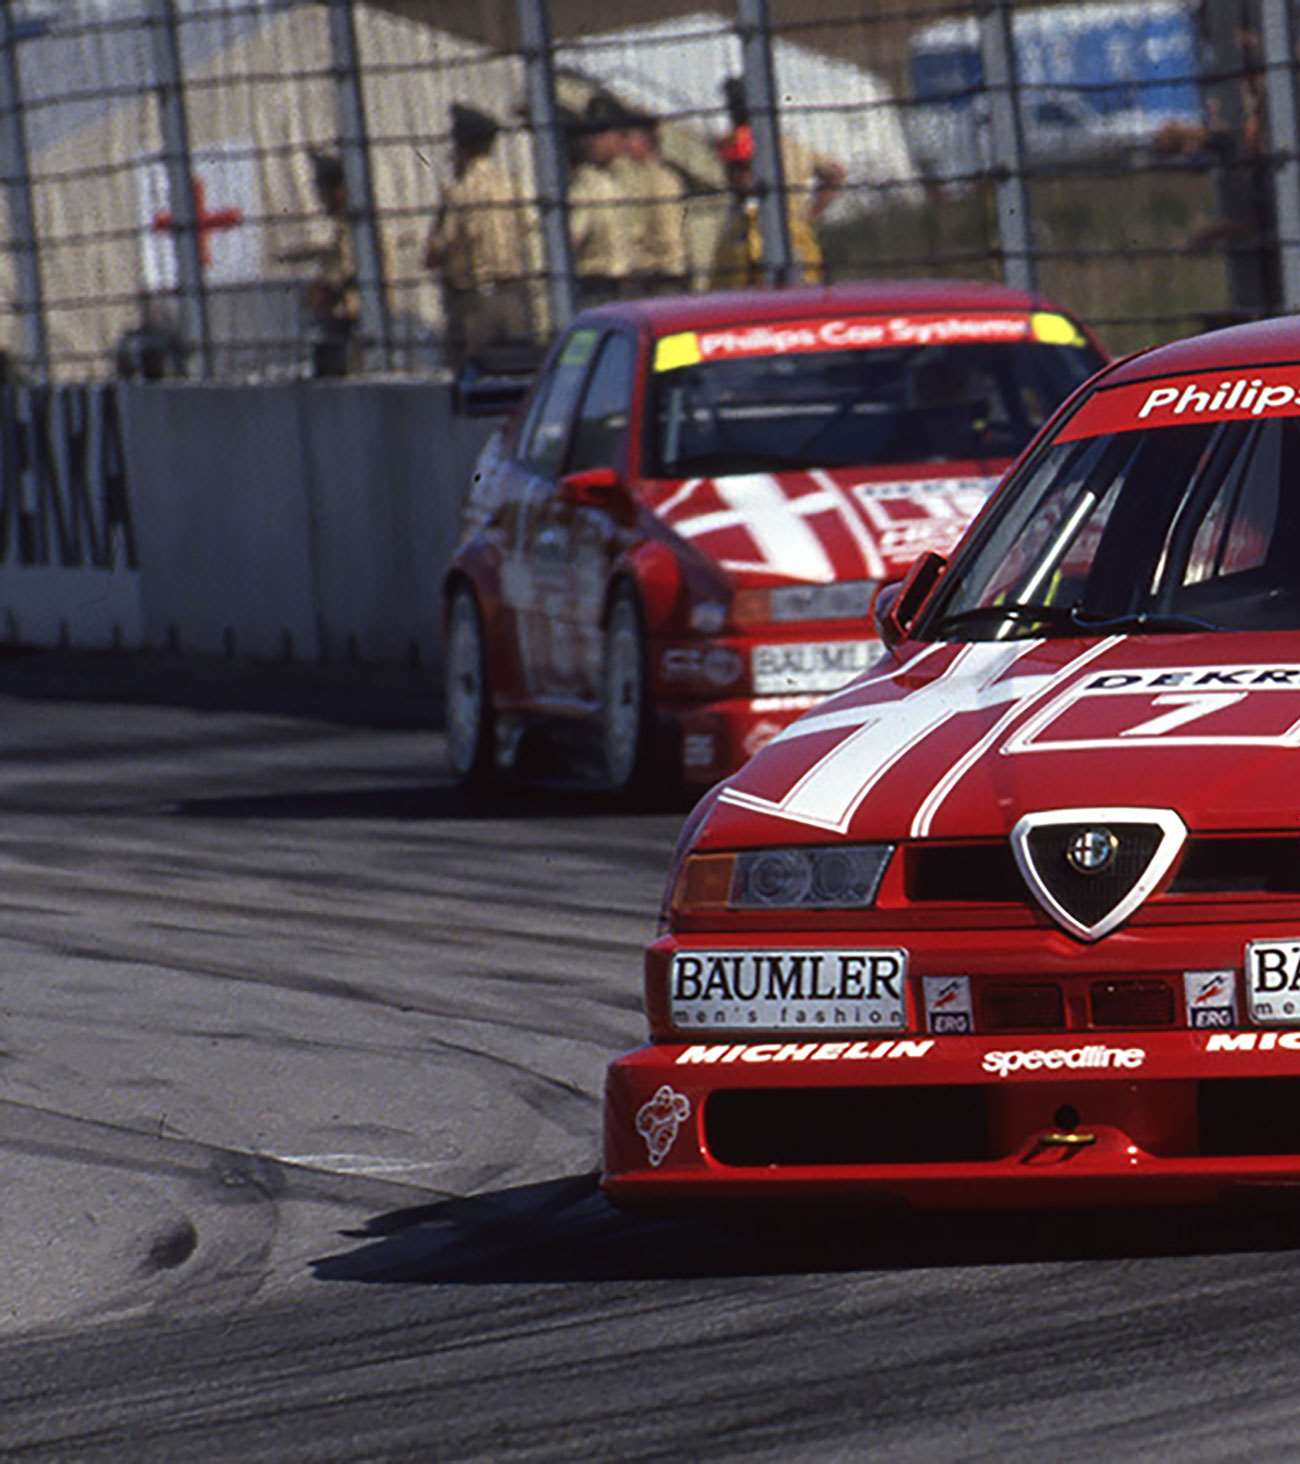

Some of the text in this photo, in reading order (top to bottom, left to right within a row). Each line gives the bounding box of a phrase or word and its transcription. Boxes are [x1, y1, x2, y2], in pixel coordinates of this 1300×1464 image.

[1119, 691, 1249, 737] 7
[673, 956, 900, 1001] BÄUMLER
[673, 1007, 902, 1024] men's fashion
[675, 1040, 935, 1064] MICHELIN
[981, 1045, 1146, 1077] speedline
